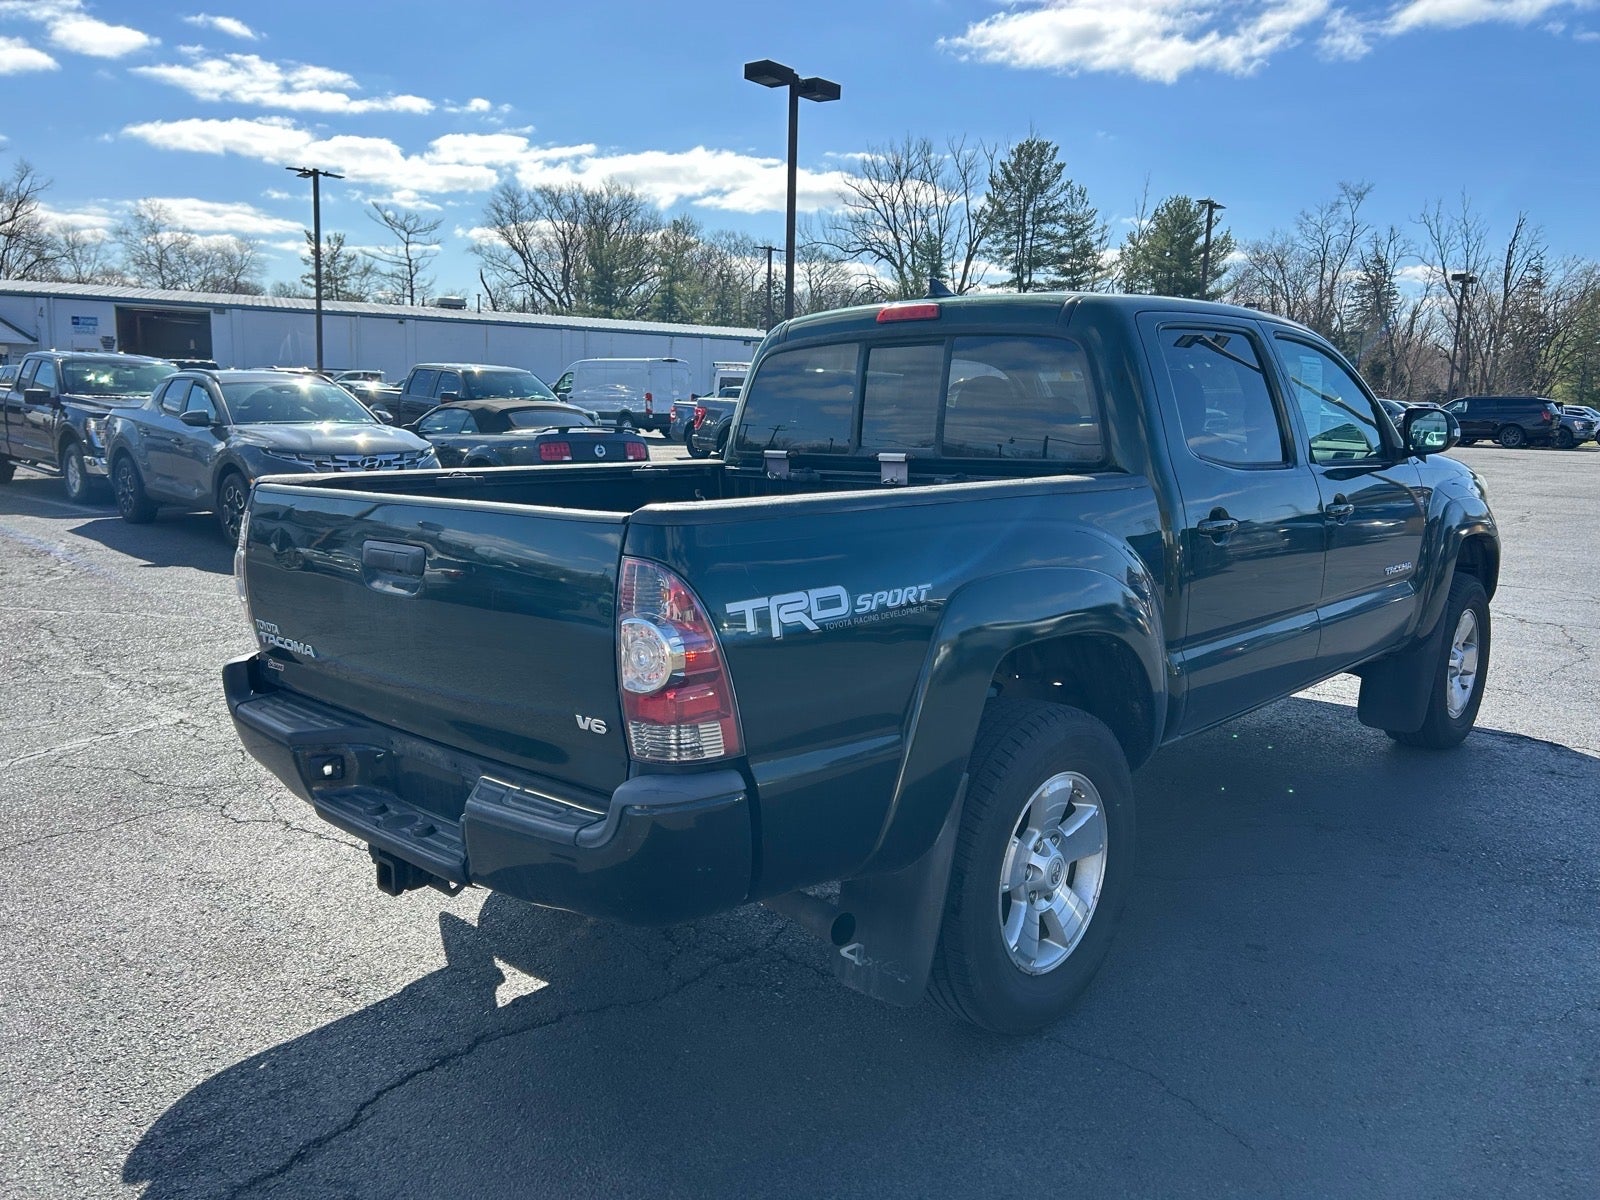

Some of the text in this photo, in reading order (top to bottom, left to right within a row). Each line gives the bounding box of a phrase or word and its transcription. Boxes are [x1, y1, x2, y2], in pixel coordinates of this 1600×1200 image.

[1384, 561, 1412, 575] TACOMA
[726, 583, 932, 639] TRD SPORT
[825, 605, 928, 631] TOYOTA RACING DEVELOPMENT
[255, 618, 280, 635] TOYOTA
[259, 631, 316, 658] TACOMA
[575, 714, 607, 735] V6
